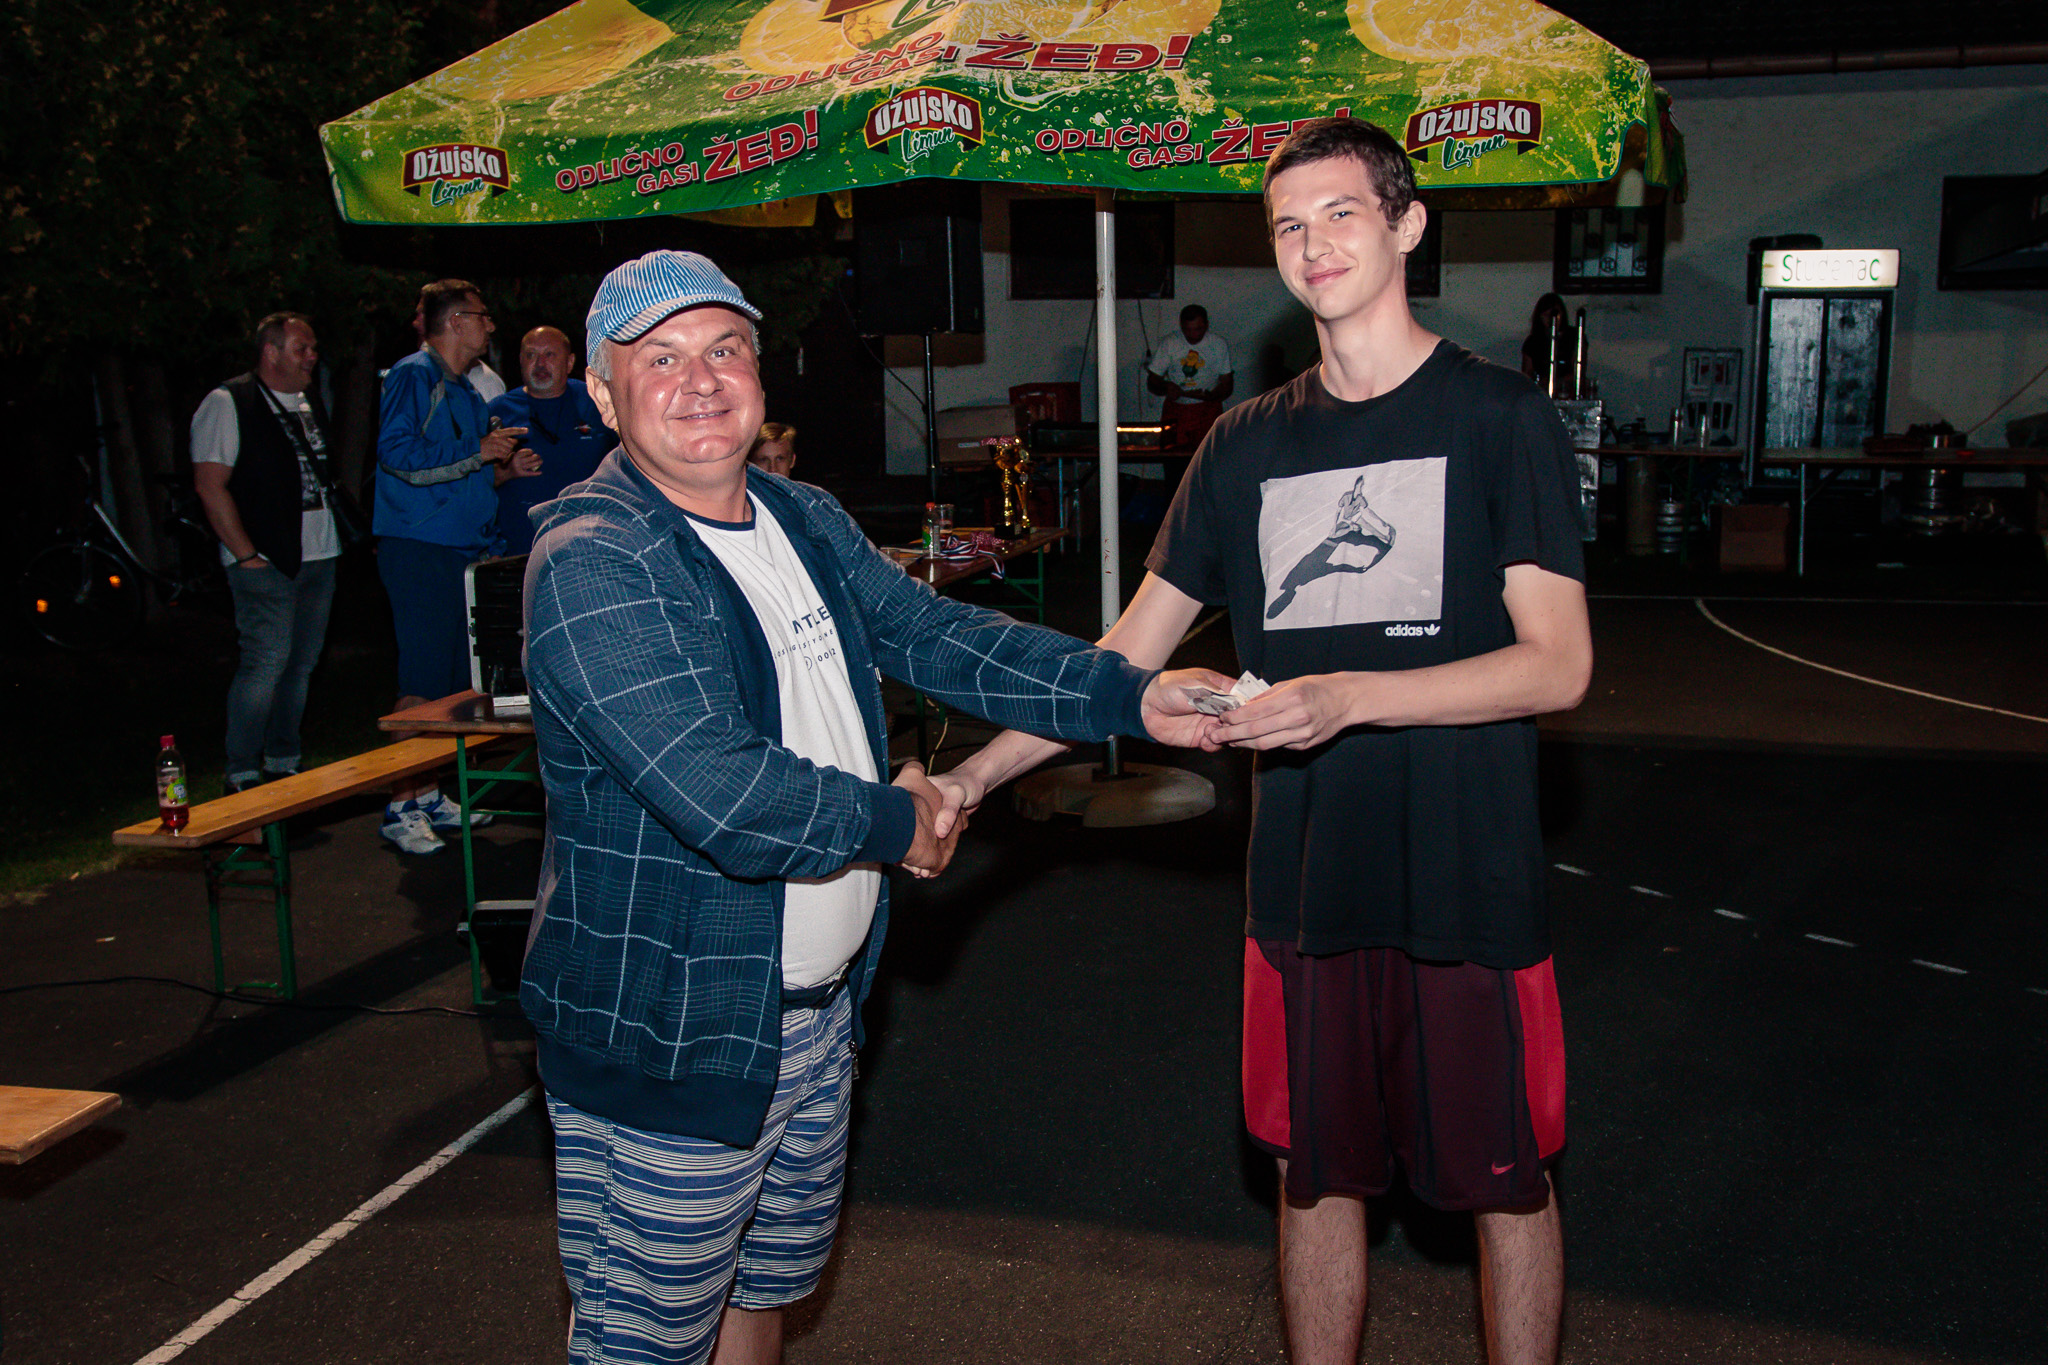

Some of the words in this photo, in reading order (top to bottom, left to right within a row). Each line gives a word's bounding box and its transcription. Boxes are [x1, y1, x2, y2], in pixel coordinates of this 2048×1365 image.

[723, 31, 945, 101] ODLIČNO
[850, 45, 960, 85] GASI
[875, 90, 973, 136] Ožujsko
[1418, 101, 1531, 142] Ožujsko
[901, 127, 955, 162] Limun
[1035, 117, 1190, 151] ODLIČNO
[1128, 143, 1202, 168] GASI
[1208, 106, 1351, 163] ŽE
[1442, 134, 1508, 170] Limun
[413, 146, 501, 180] Ožujsko
[555, 142, 684, 192] ODLIČNO
[636, 161, 699, 194] GASI
[431, 177, 484, 207] Limun
[1385, 624, 1423, 636] adidas
